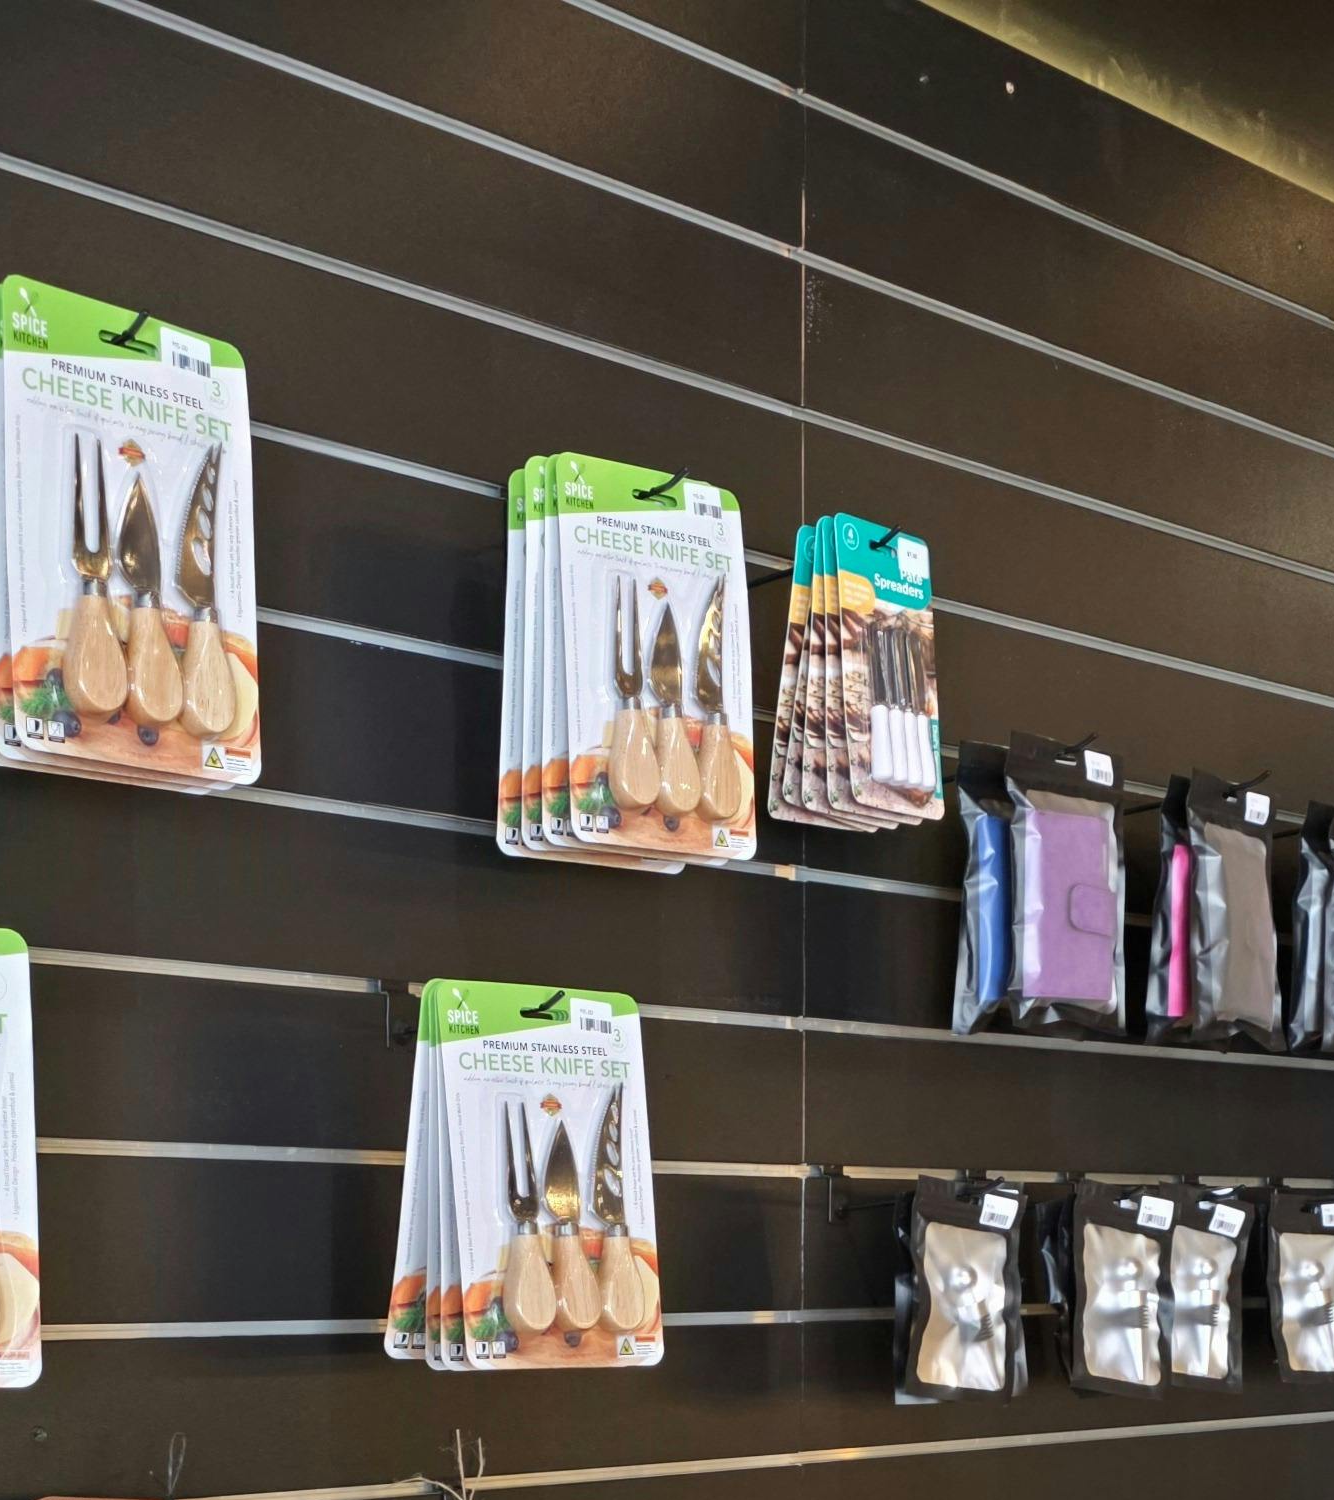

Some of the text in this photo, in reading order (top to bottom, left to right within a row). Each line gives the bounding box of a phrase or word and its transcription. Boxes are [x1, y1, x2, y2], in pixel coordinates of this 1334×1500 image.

[12, 311, 48, 338] SPICE
[13, 331, 49, 351] KITCHEN
[51, 358, 204, 410] PREMIUM STAINLESS STEEL
[212, 381, 221, 397] 3
[22, 367, 113, 409] CHEESE
[121, 392, 188, 431] KNIFE
[195, 414, 232, 442] SET
[564, 481, 594, 500] SPICE
[565, 498, 594, 510] KITCHEN
[597, 515, 712, 547] PREMIUM STAINLESS STEEL
[717, 522, 723, 536] 3
[574, 525, 644, 555] CHEESE
[650, 540, 700, 565] KNIFE
[706, 553, 732, 573] SET
[874, 572, 924, 600] Spreaders
[447, 1009, 479, 1025] SPICE
[449, 1023, 480, 1035] KITCHEN
[614, 1029, 621, 1042] 3
[483, 1040, 528, 1051] PREMIUM
[531, 1042, 579, 1055] STAINLESS
[581, 1046, 608, 1057] STEEL
[458, 1051, 631, 1079] CHEESE KNIFE SET
